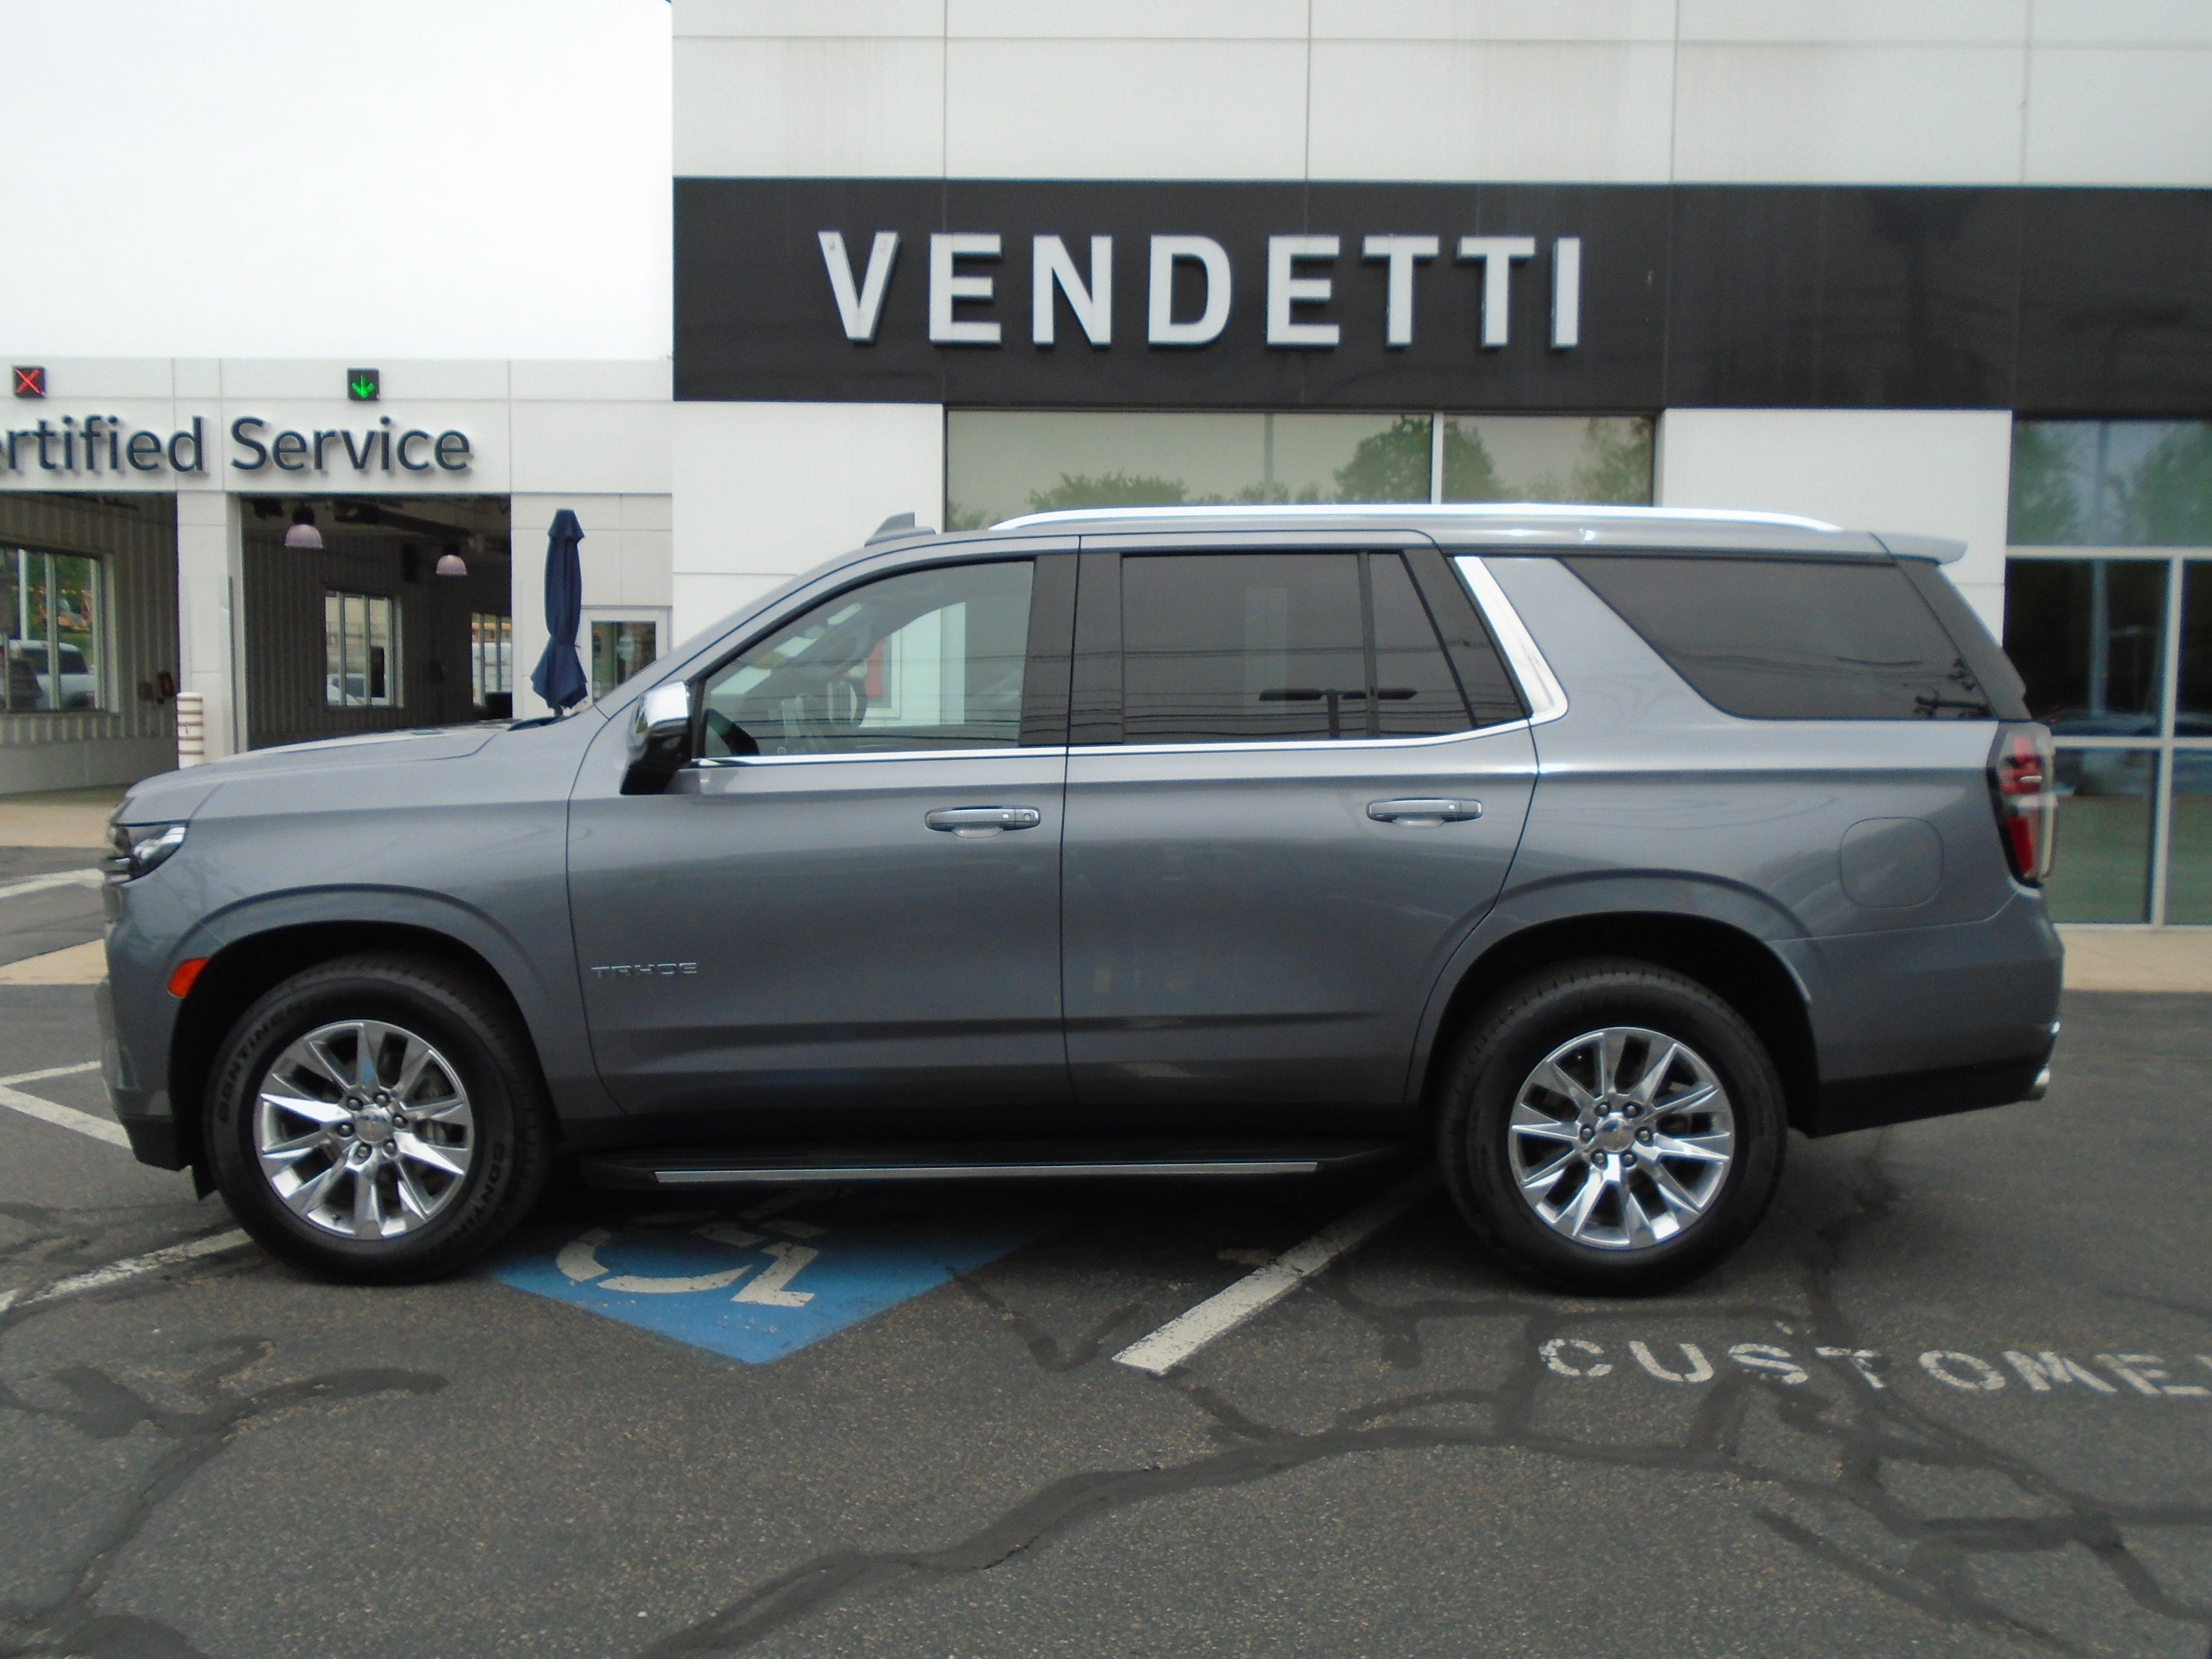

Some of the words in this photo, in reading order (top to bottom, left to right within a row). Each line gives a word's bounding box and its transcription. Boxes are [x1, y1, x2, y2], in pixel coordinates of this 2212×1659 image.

[817, 230, 1581, 347] VENDETTI
[0, 416, 204, 473] rtified
[231, 415, 470, 474] Service
[591, 962, 698, 977] TAHOE
[1538, 1337, 2212, 1397] CUSTOME
